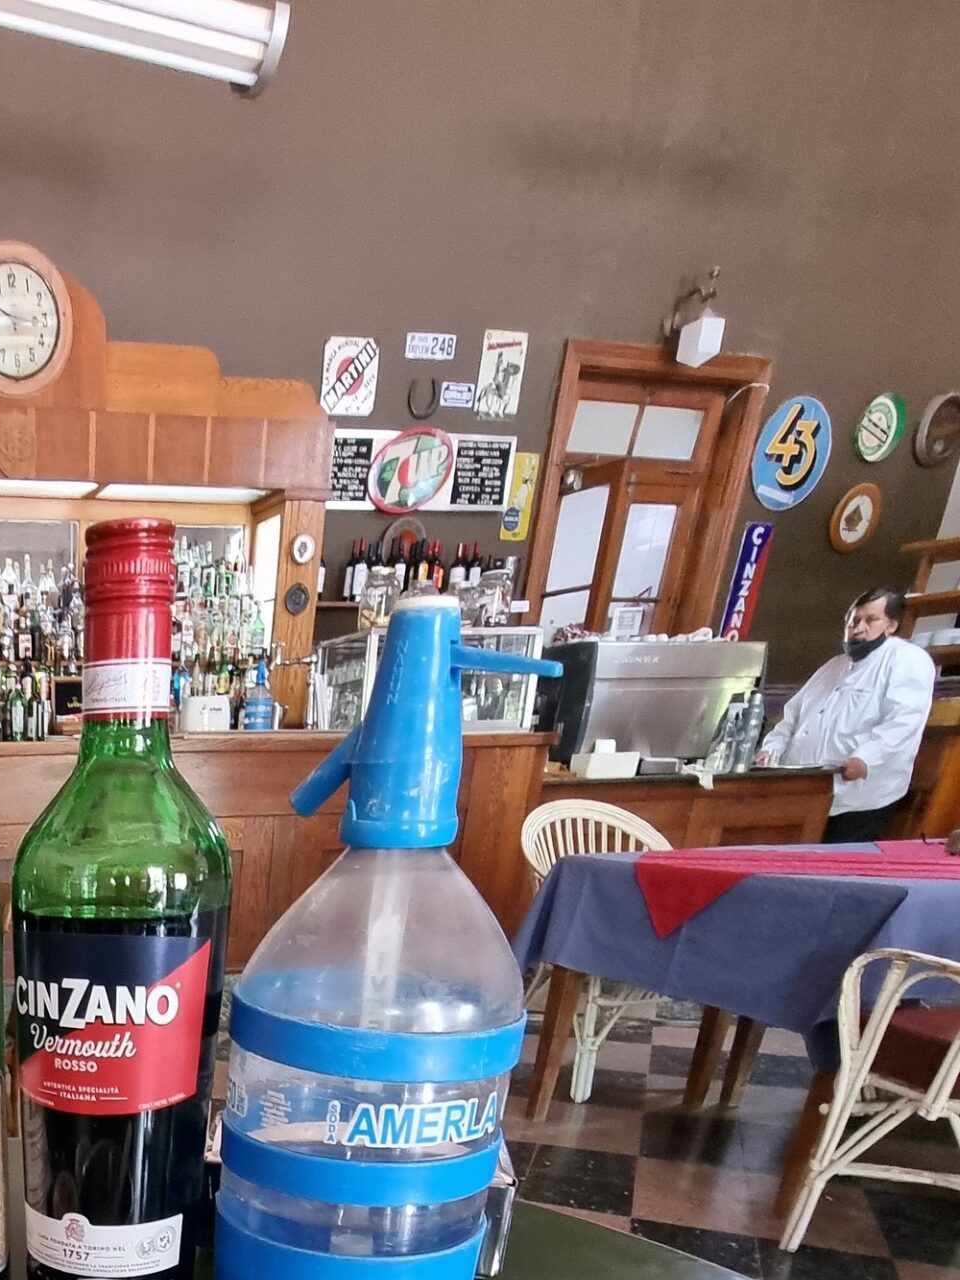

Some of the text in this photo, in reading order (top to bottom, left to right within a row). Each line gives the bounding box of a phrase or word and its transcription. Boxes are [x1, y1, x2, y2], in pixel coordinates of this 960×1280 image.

[7, 273, 16, 289] 12
[36, 292, 42, 307] 2
[42, 312, 48, 328] 3
[38, 333, 45, 349] 4
[431, 336, 454, 356] 248
[0, 348, 6, 364] 7
[14, 353, 21, 368] 6
[29, 347, 35, 362] 5
[323, 340, 377, 411] MARTINI
[765, 403, 820, 488] 43
[381, 436, 450, 504] 7UP
[726, 526, 765, 641] CINZANO
[16, 975, 179, 1029] CINZANO
[30, 1022, 137, 1058] Vermouth
[54, 1057, 98, 1073] ROSSO
[43, 1081, 77, 1092] AUTENTICA
[59, 1092, 97, 1102] ITALIANA
[326, 1103, 339, 1142] SODA
[344, 1092, 498, 1146] AMERLA
[62, 1248, 90, 1261] 1757
